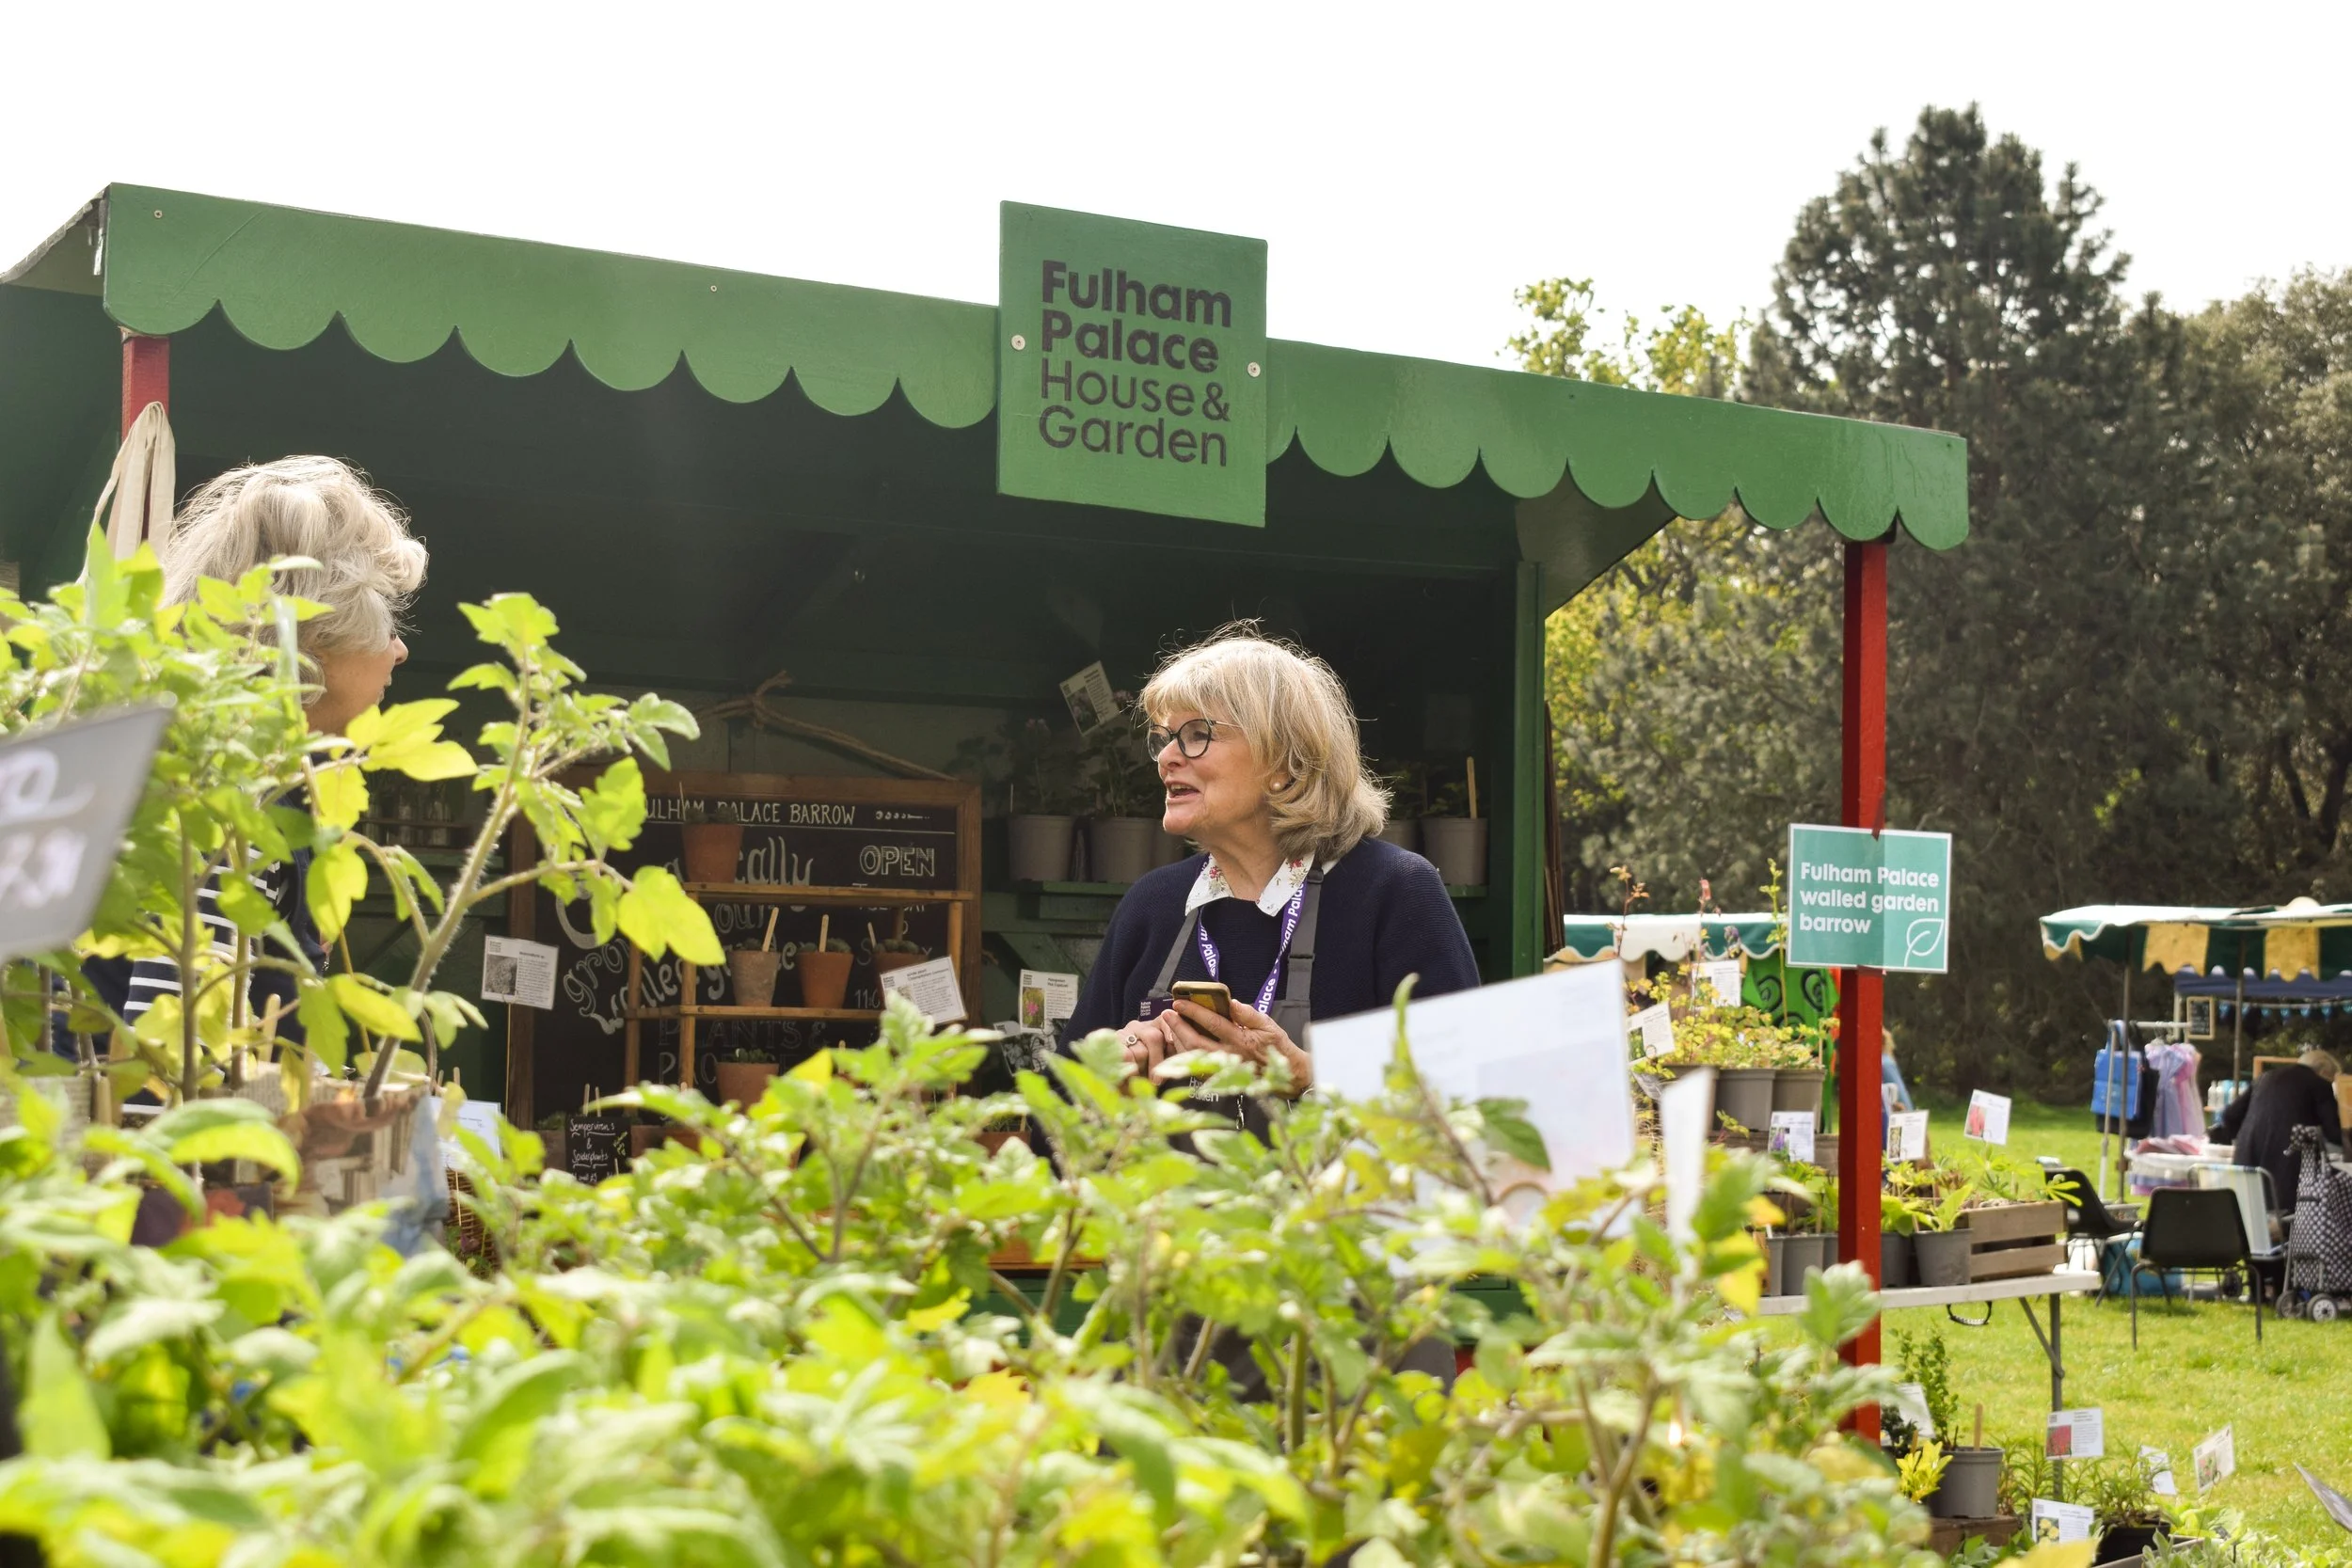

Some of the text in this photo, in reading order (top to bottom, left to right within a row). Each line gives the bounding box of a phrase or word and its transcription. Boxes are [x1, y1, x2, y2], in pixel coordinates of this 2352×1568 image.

[1041, 259, 1232, 328] Fulham
[1041, 309, 1219, 374] Palace
[1038, 404, 1228, 467] Garden
[644, 799, 705, 821] ULHAM
[789, 803, 856, 826] BARROW
[859, 845, 935, 877] OPEN
[1800, 862, 1940, 888] Fulham Palace
[1799, 889, 1939, 913] walled garden
[1799, 912, 1872, 934] barrow
[1258, 978, 1277, 1014] alace
[658, 1018, 803, 1050] PANTS
